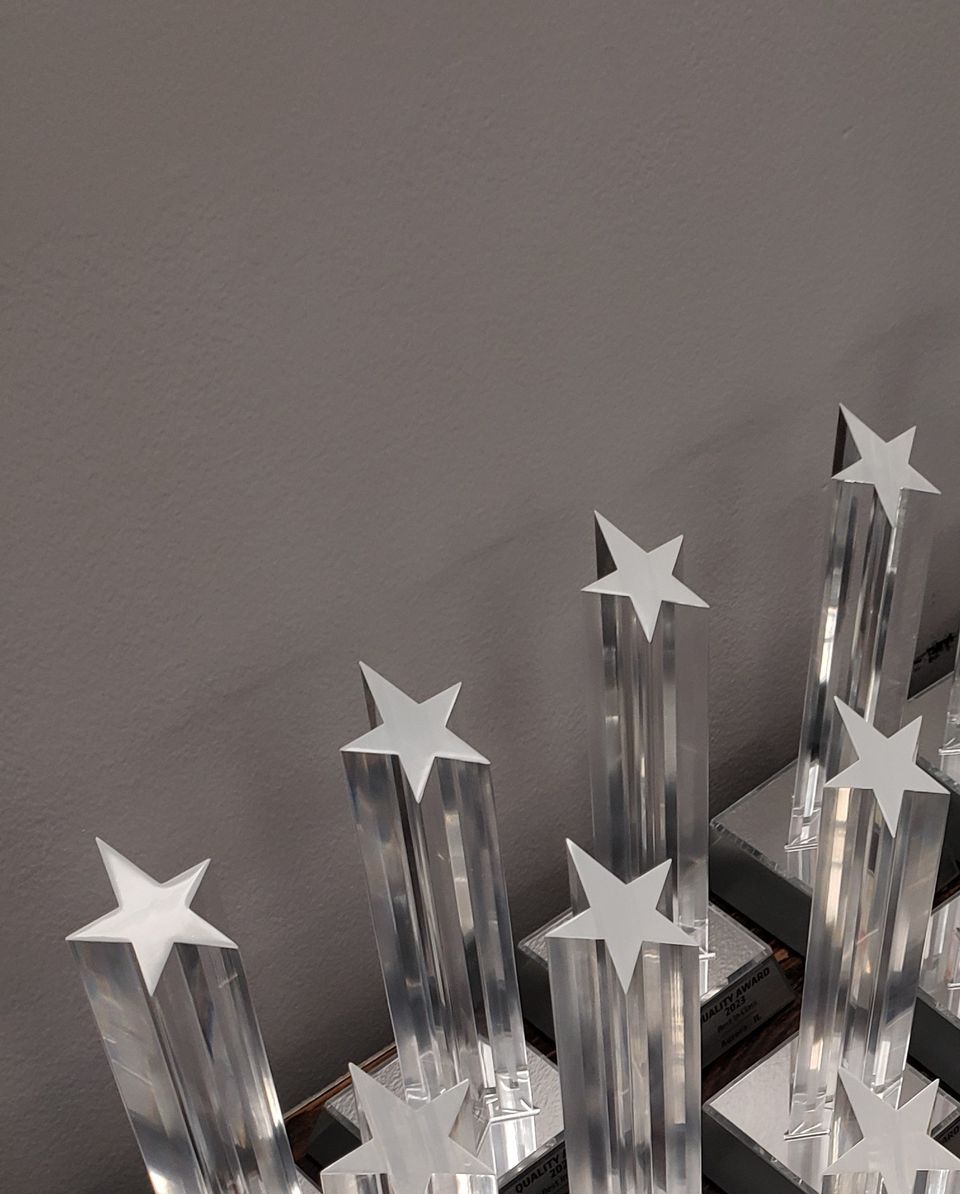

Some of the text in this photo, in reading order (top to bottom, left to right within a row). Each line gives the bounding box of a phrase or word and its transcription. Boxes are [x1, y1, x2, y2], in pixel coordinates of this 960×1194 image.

[702, 967, 770, 1022] UALITY AWARD
[725, 995, 746, 1016] 2023
[942, 1125, 960, 1143] ARD
[515, 1154, 559, 1193] QUALITY
